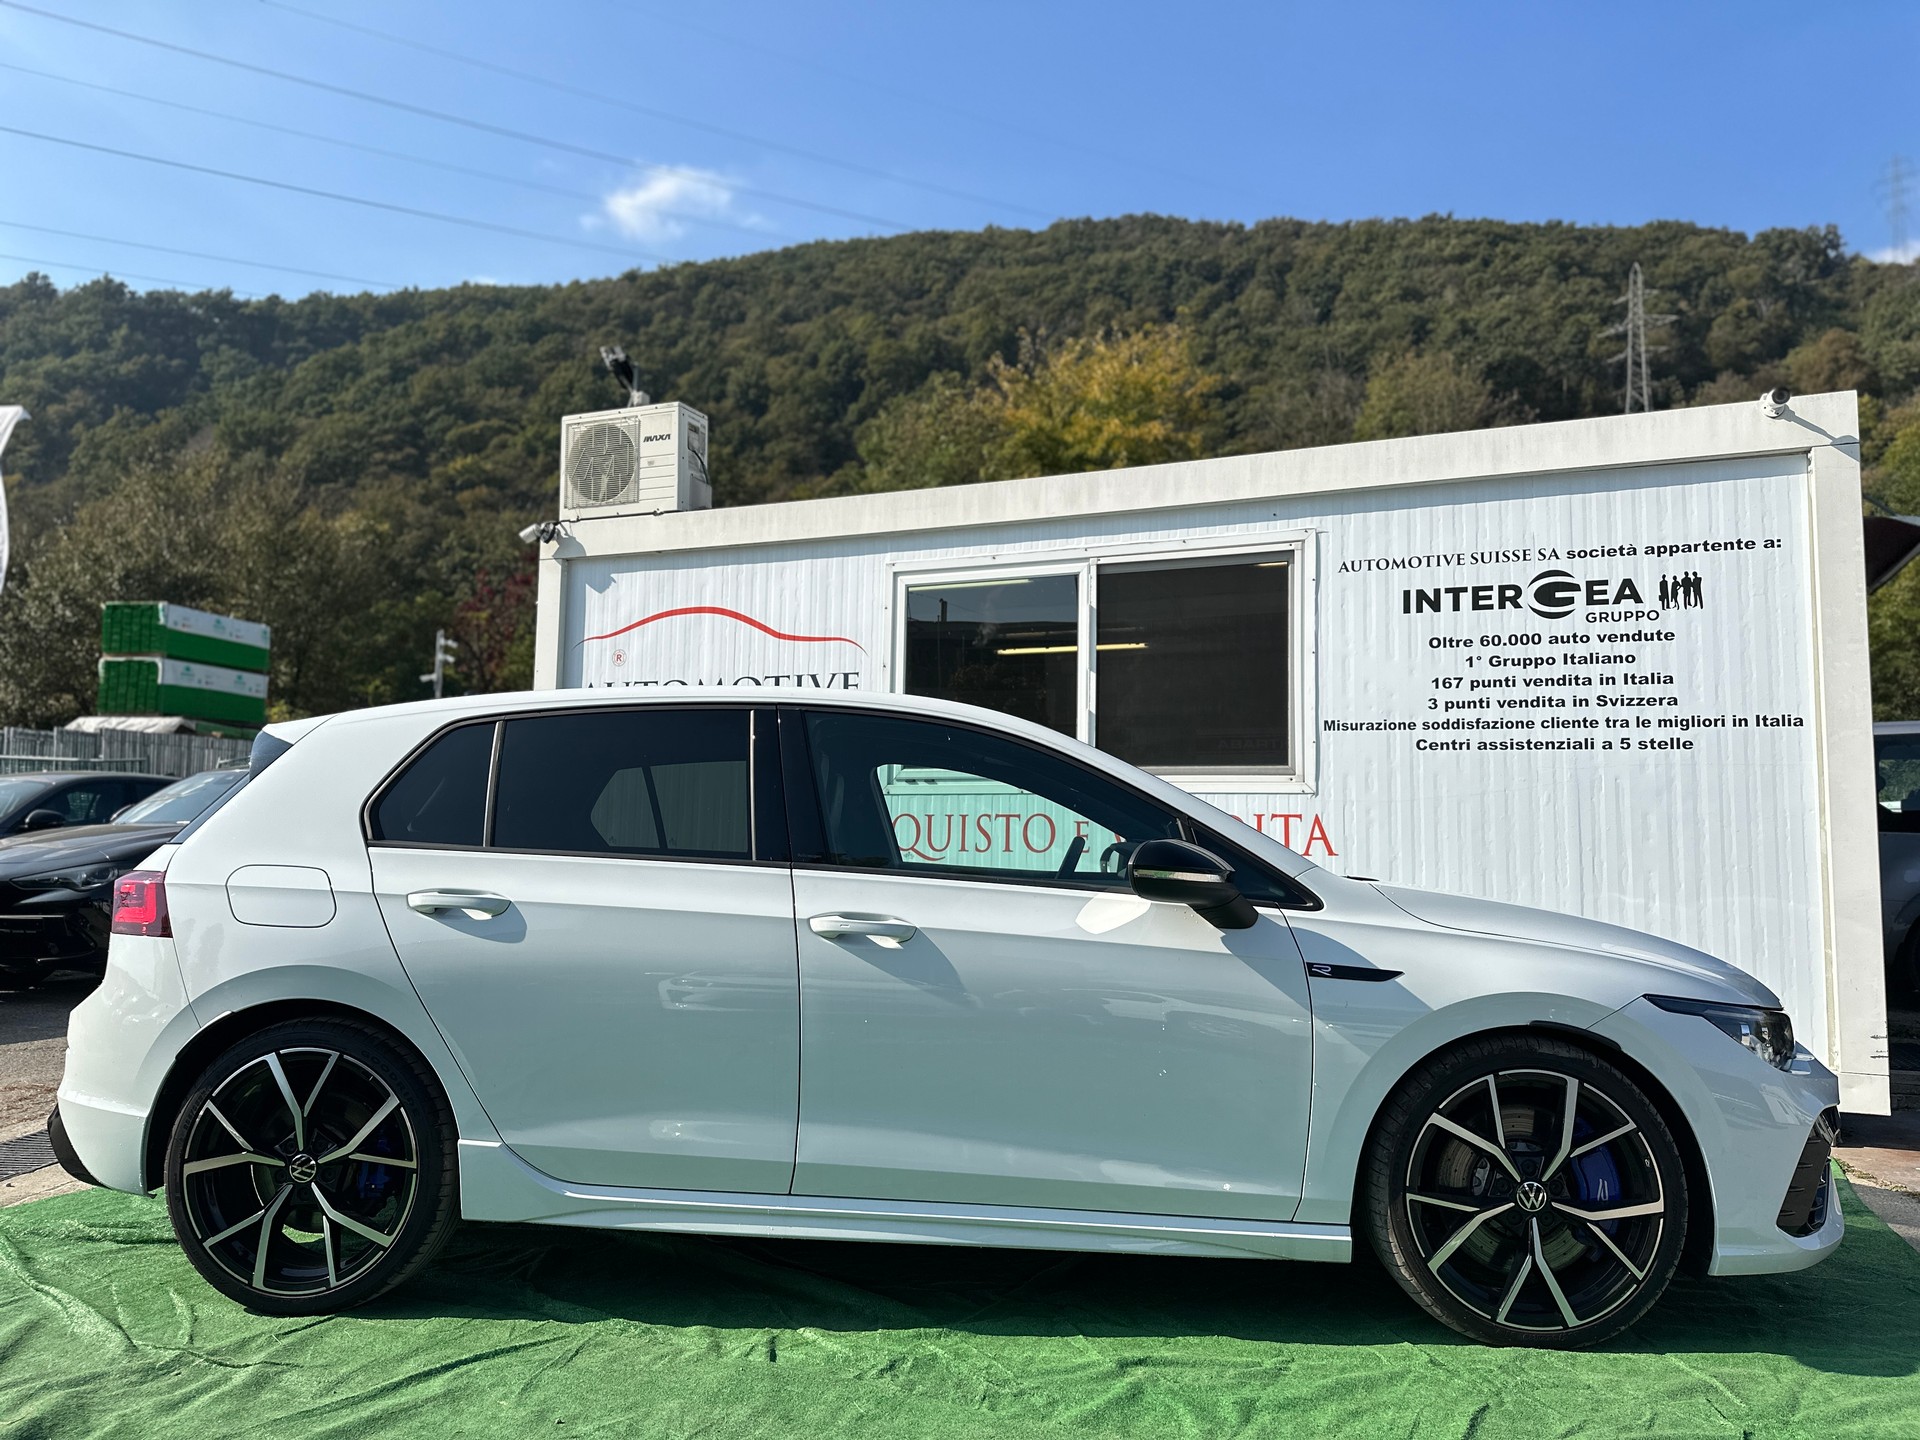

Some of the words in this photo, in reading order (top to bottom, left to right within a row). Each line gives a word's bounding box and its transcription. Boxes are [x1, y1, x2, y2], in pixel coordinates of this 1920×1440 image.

[643, 433, 671, 443] MAXA
[1338, 553, 1466, 573] AUTOMOTIVE
[1470, 548, 1532, 565] SUISSE
[1537, 547, 1561, 562] SA
[1566, 543, 1638, 560] società
[1643, 538, 1757, 557] appartente
[1763, 538, 1782, 549] a:
[1585, 609, 1660, 623] GRUPPO
[1428, 636, 1474, 649] Oltre
[1479, 632, 1542, 647] 60.000
[1548, 632, 1591, 645] auto
[1596, 629, 1676, 643] vendute
[1488, 655, 1557, 670] Gruppo
[1563, 652, 1636, 666] Italiano
[1431, 676, 1464, 690] 167
[1470, 675, 1516, 692] punti
[1522, 674, 1593, 688] vendita
[1599, 673, 1616, 686] in
[1623, 672, 1674, 686] Italia
[1427, 697, 1439, 710] 3
[1444, 696, 1491, 713] punti
[1496, 695, 1566, 709] vendita
[1572, 695, 1590, 708] in
[1595, 694, 1679, 707] Svizzera
[1323, 718, 1417, 732] Misurazione
[1422, 717, 1536, 731] soddisfazione
[1540, 716, 1600, 729] cliente
[1604, 716, 1630, 729] tra
[1635, 715, 1652, 729] le
[1657, 714, 1726, 732] migliori
[1732, 714, 1749, 728] in
[1755, 714, 1804, 728] Italia
[1415, 738, 1471, 751] Centri
[1476, 737, 1595, 751] assistenziali
[1601, 740, 1613, 750] a
[1619, 737, 1631, 750] 5
[1637, 737, 1694, 750] stelle
